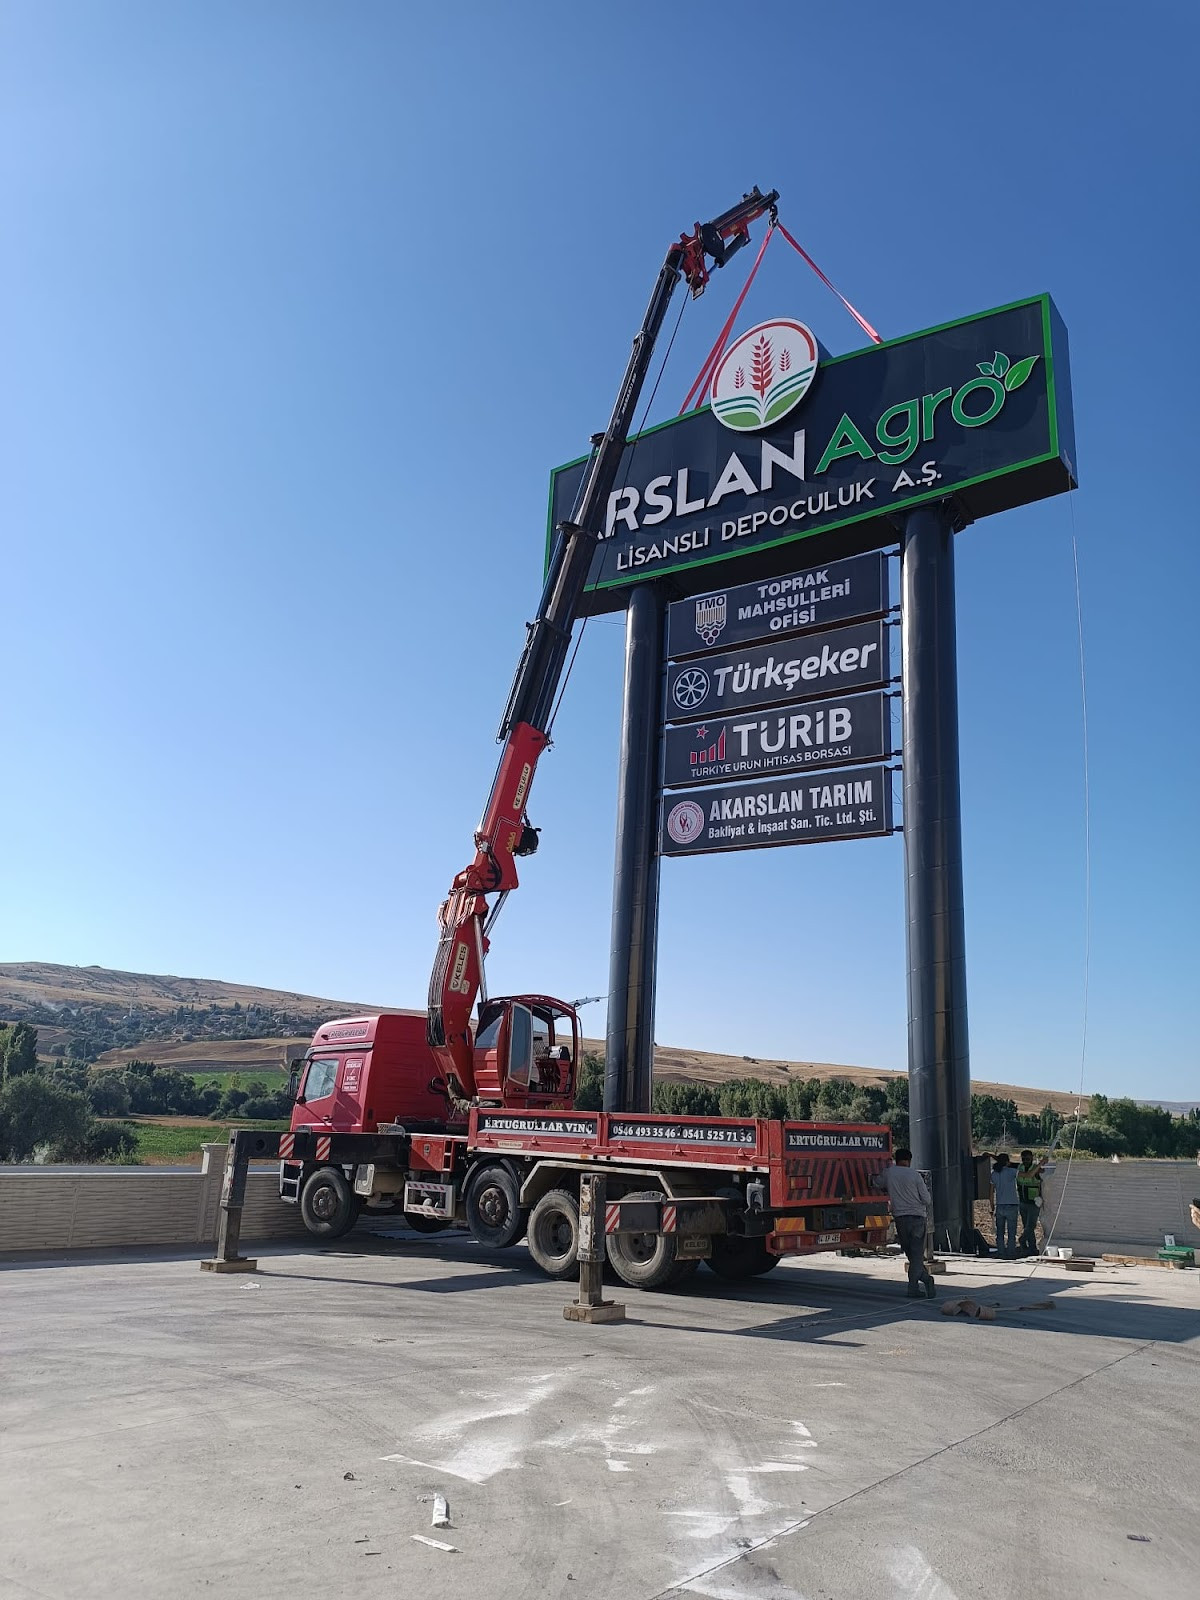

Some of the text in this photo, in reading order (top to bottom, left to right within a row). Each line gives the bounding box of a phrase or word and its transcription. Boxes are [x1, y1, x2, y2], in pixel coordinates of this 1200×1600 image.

[597, 376, 1006, 540] RSLAN Agro
[616, 460, 942, 571] LİSANSLI DEPOCULUK A.Ş.
[738, 578, 850, 620] MAHSULLERİ
[757, 569, 829, 598] TOPRAK
[696, 596, 726, 611] TMO
[769, 605, 816, 631] OFİSİ
[713, 643, 877, 697] Türkşeker
[804, 745, 852, 761] BORSASI
[708, 789, 803, 822] AKARSLAN
[809, 780, 873, 809] TARIM
[708, 808, 877, 840] Bakliyat & İnşaat San. Tic. Ltd. Şti.
[612, 1125, 634, 1136] 0546
[635, 1127, 651, 1138] 493
[652, 1128, 664, 1138] 35
[664, 1128, 676, 1139] 46
[682, 1129, 704, 1140] 0541
[706, 1130, 724, 1141] 525
[726, 1131, 738, 1142] 71
